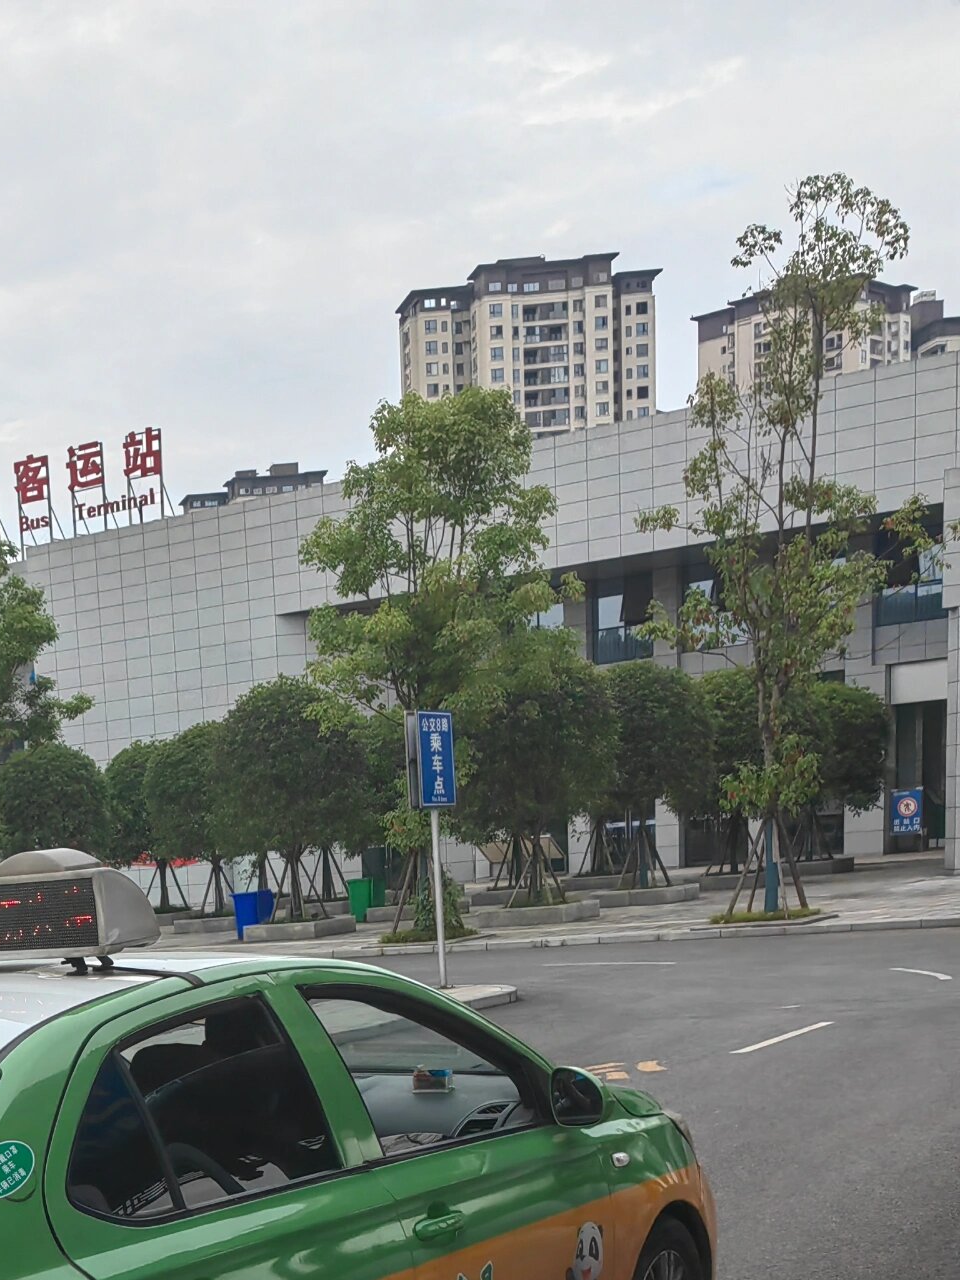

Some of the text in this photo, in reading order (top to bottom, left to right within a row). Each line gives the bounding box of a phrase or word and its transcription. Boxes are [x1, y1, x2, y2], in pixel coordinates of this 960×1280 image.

[20, 488, 156, 532] Bus Terminal
[422, 717, 449, 732] 公交8路
[430, 732, 445, 795] 乘车点
